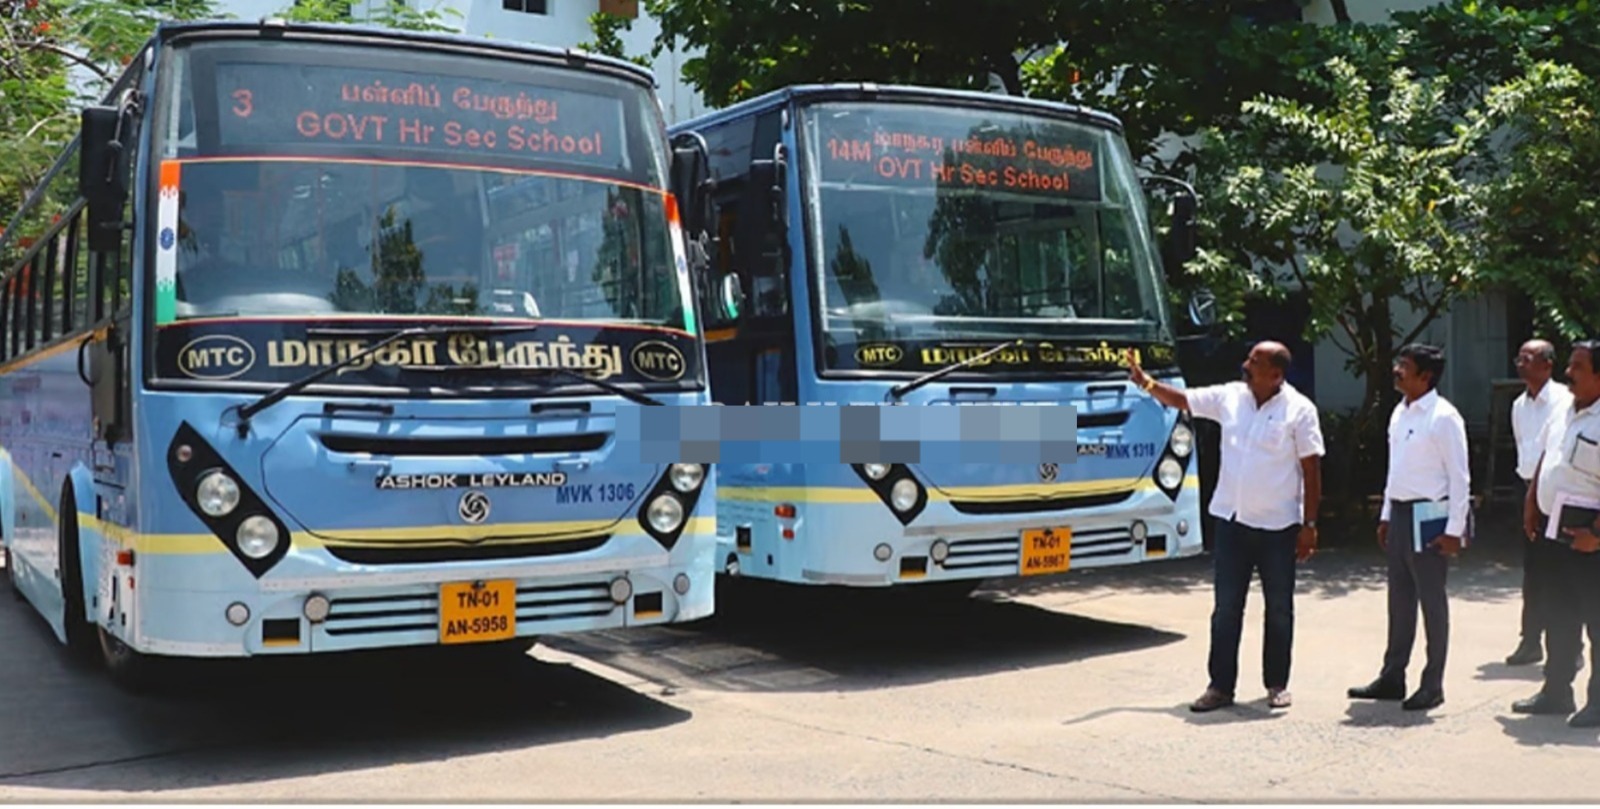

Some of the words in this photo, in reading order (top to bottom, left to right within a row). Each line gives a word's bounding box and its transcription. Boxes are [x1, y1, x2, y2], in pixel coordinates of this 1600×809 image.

[232, 90, 254, 117] 3
[342, 80, 441, 107] பள்ளிப்
[453, 87, 558, 123] பேருந்து
[296, 112, 388, 141] GOVT
[400, 118, 434, 145] Hr
[444, 121, 497, 149] Sec
[507, 125, 602, 155] School
[827, 138, 872, 162] 14M
[874, 156, 923, 179] OVT
[930, 161, 955, 183] Hr
[960, 162, 999, 186] Sec
[1003, 165, 1070, 191] School
[188, 346, 245, 369] MTC
[637, 350, 681, 372] MTC
[863, 347, 896, 363] MTC
[379, 474, 458, 489] ASHOK
[469, 472, 568, 488] LEYLAND
[555, 485, 594, 505] MVK
[599, 483, 636, 502] 1306
[456, 589, 501, 609] TN-01
[445, 615, 509, 636] AN-5958
